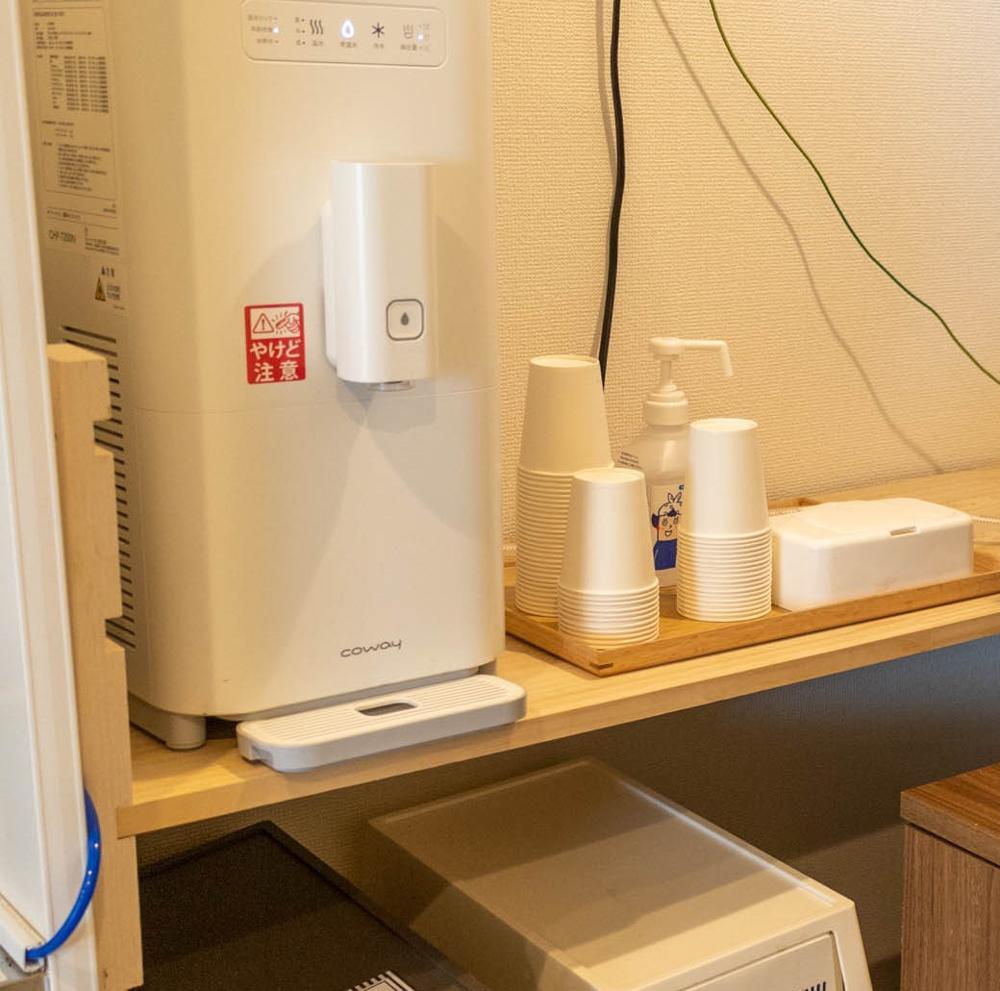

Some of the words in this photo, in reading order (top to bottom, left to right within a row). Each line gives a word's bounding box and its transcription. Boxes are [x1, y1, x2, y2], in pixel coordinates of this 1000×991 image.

[250, 339, 302, 360] やけど
[253, 360, 299, 382] 注意
[340, 639, 402, 658] coway
